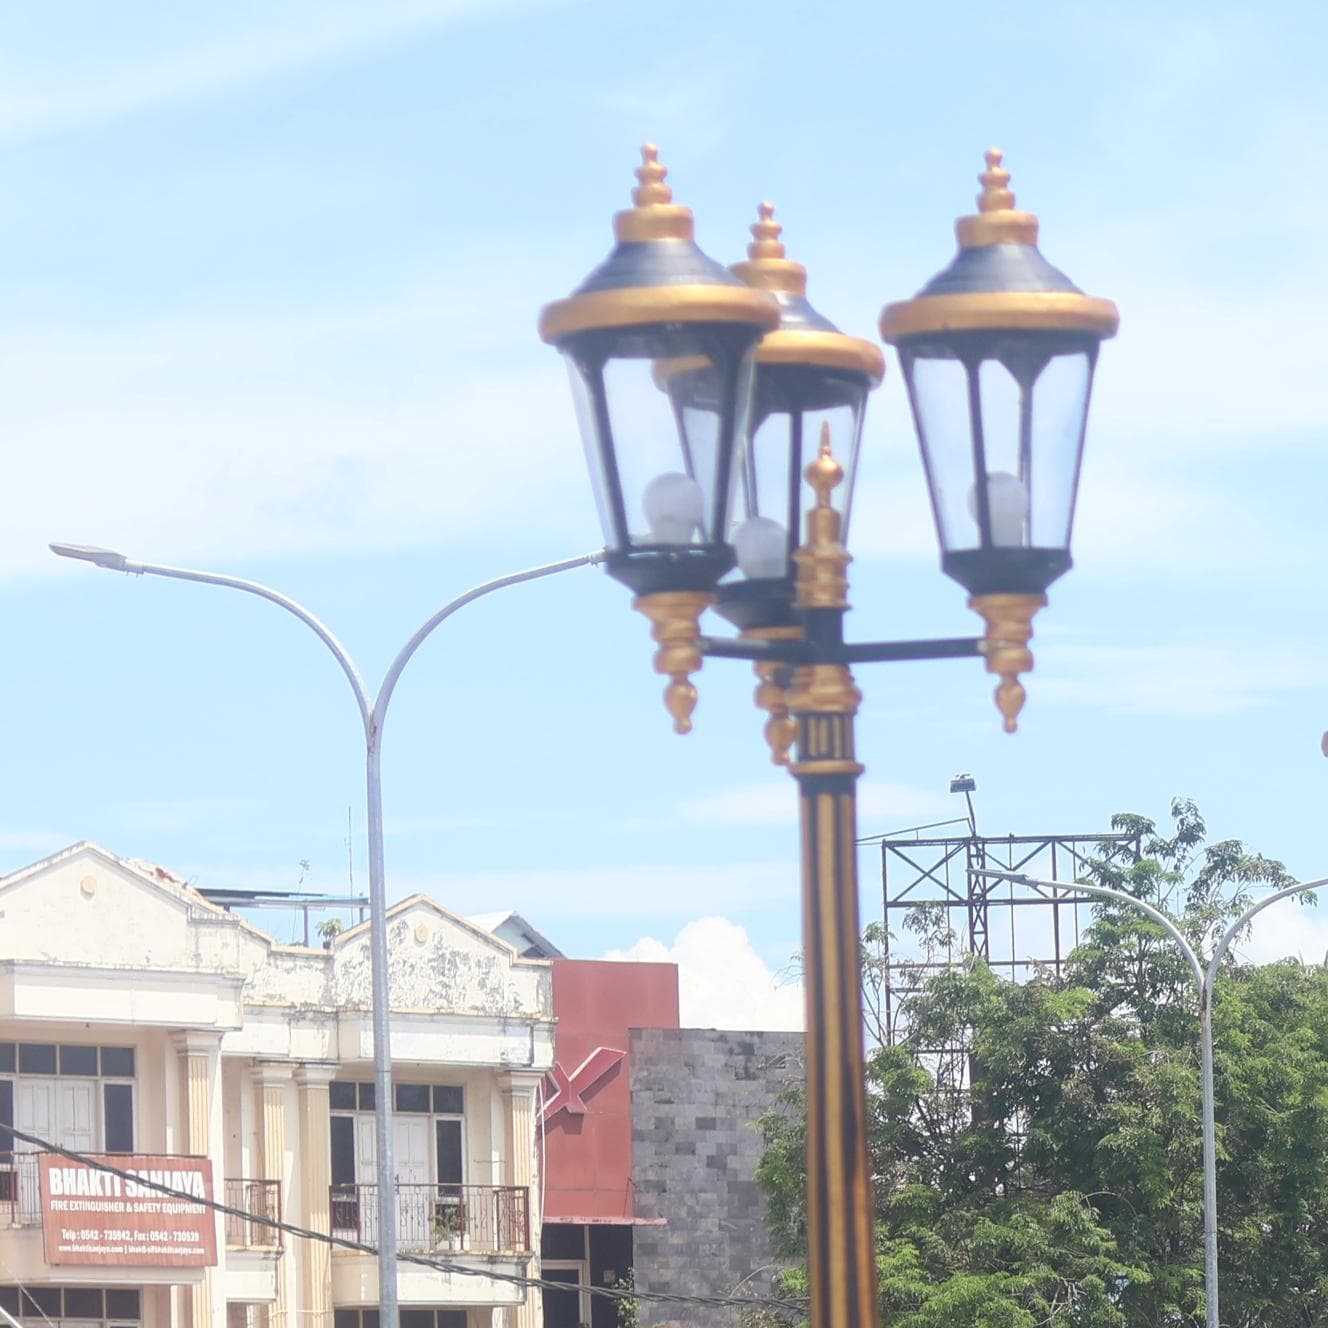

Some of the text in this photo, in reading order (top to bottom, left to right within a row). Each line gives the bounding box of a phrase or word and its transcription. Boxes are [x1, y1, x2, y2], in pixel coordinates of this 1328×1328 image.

[49, 1168, 206, 1199] BHAKTI SANJAYA
[51, 1200, 206, 1215] FIRE EXTINGUISHER & SAFETY EQUIPMENT
